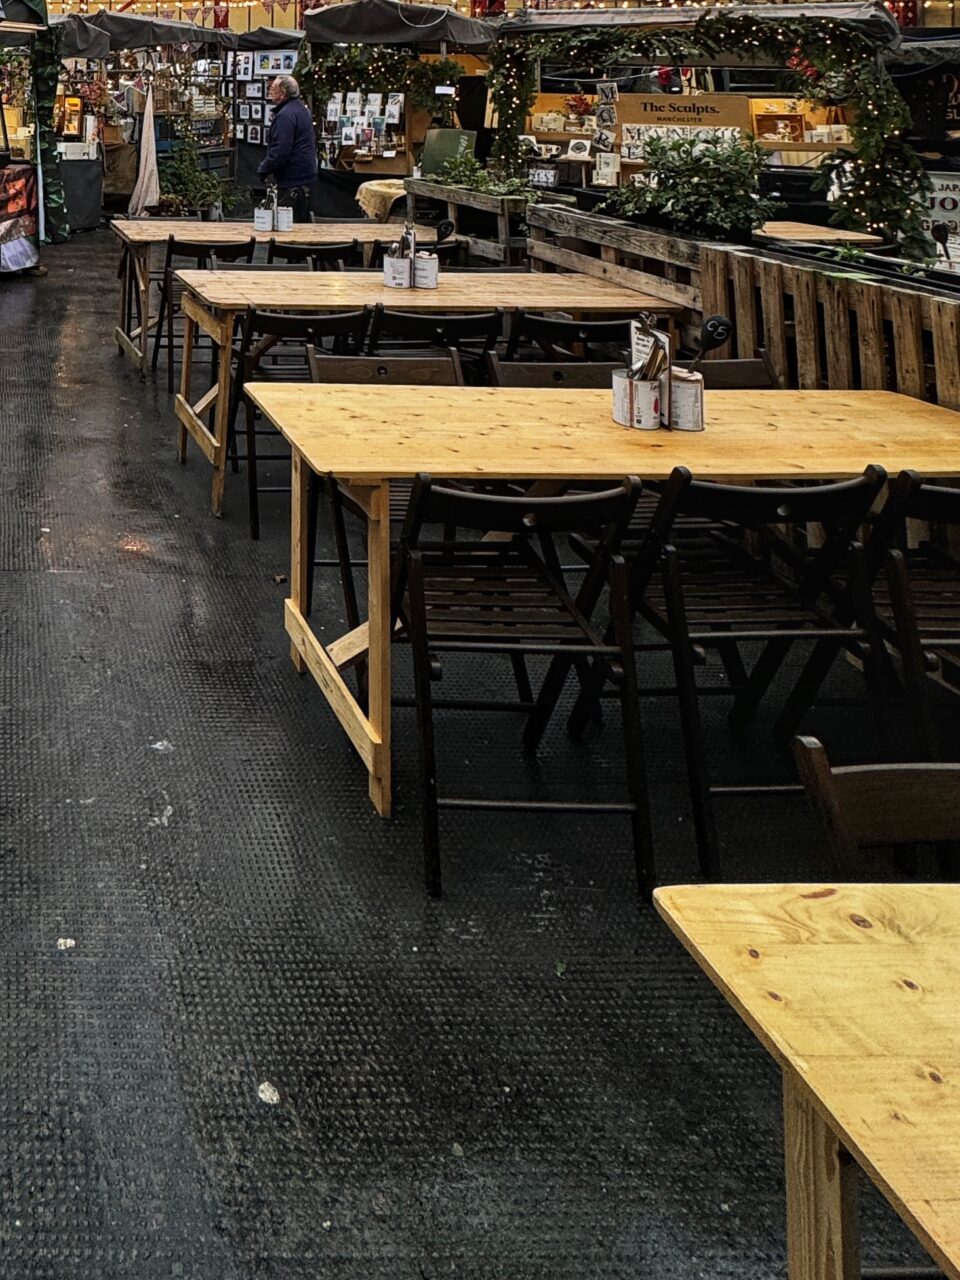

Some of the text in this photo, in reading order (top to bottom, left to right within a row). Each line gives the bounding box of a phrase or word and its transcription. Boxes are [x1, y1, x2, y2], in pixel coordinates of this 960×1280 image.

[641, 102, 720, 115] The Sculpts.
[938, 184, 960, 192] JAP
